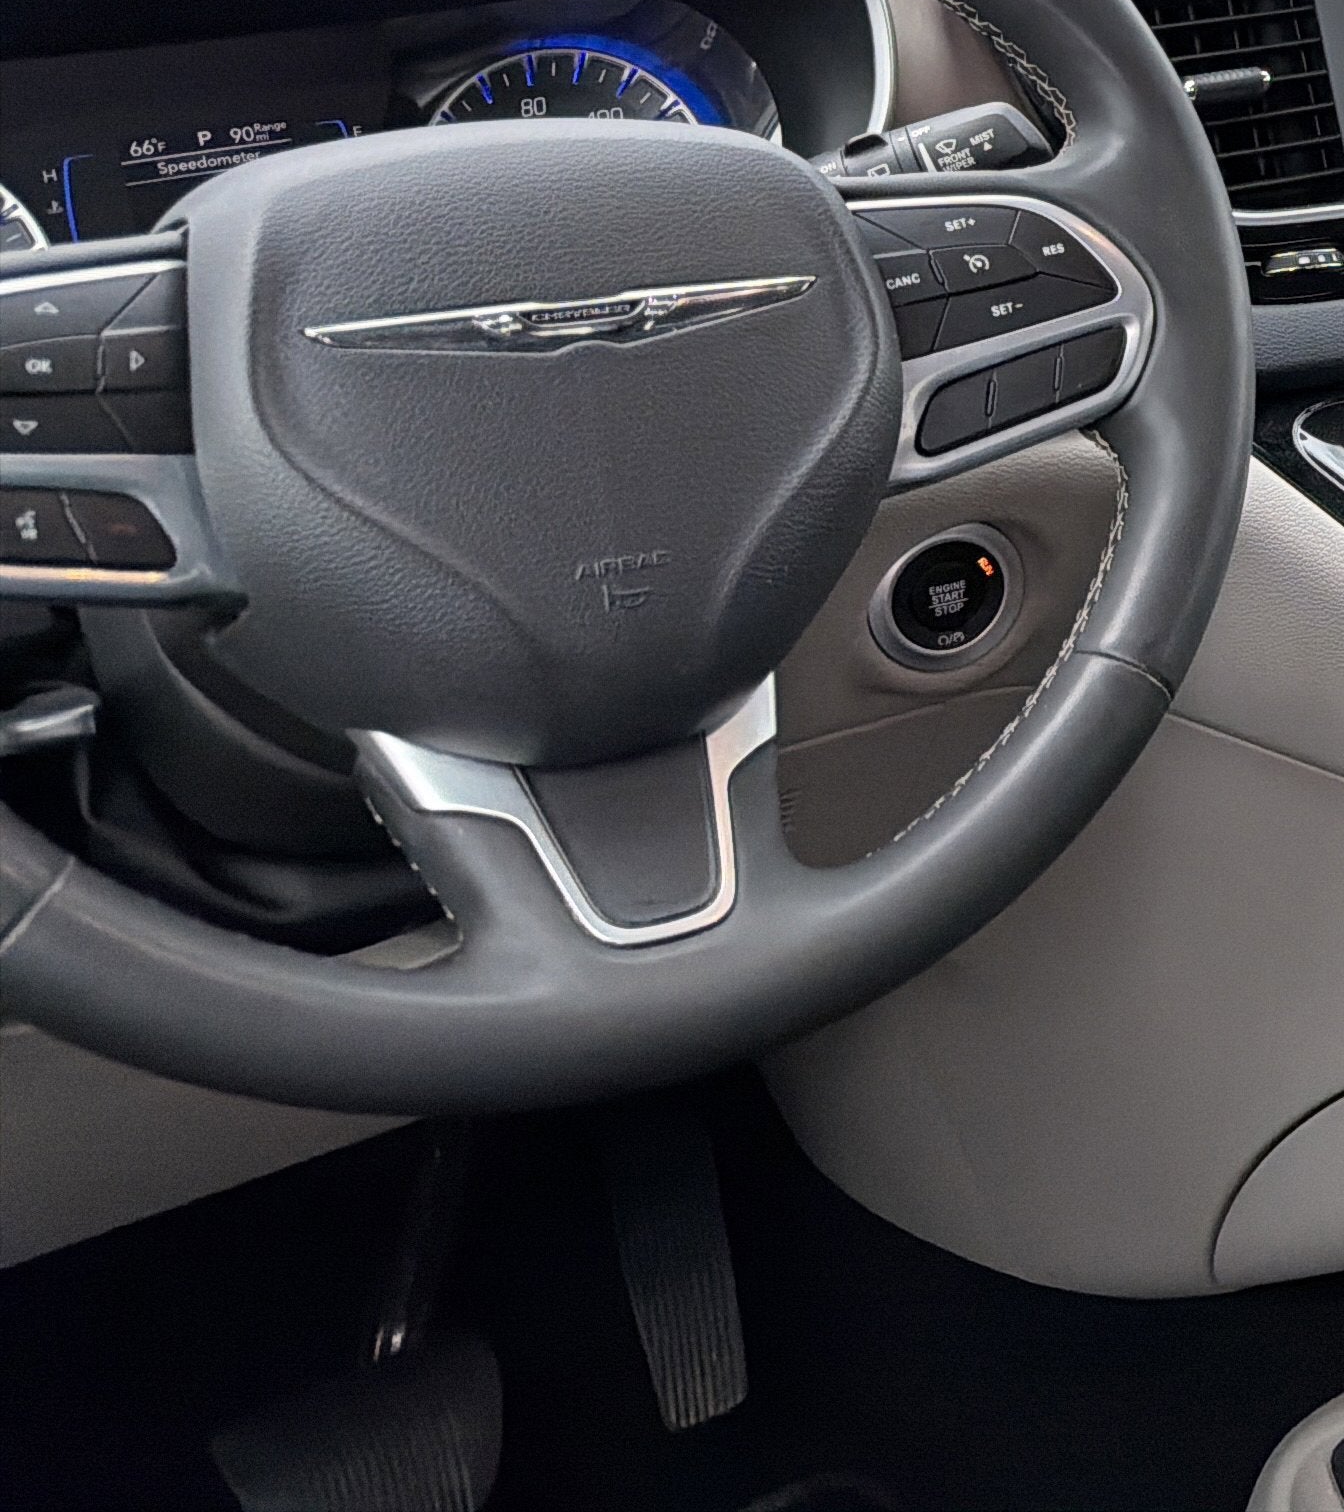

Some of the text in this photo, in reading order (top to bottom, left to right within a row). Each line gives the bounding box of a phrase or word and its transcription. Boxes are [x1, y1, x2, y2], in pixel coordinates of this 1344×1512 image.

[520, 97, 547, 118] 80
[196, 131, 212, 146] P
[229, 127, 254, 142] 90
[253, 120, 288, 132] Range
[255, 132, 270, 141] mi
[911, 125, 931, 138] OFF
[969, 128, 995, 146] MIST
[157, 148, 262, 176] Speedometer
[937, 147, 971, 167] FRONT
[42, 168, 58, 184] H
[944, 217, 977, 233] SET+
[1041, 242, 1065, 257] RES
[885, 272, 922, 290] CANC
[24, 357, 53, 375] OK
[928, 579, 967, 596] ENGINE
[931, 589, 966, 605] START
[934, 602, 965, 617] STOP
